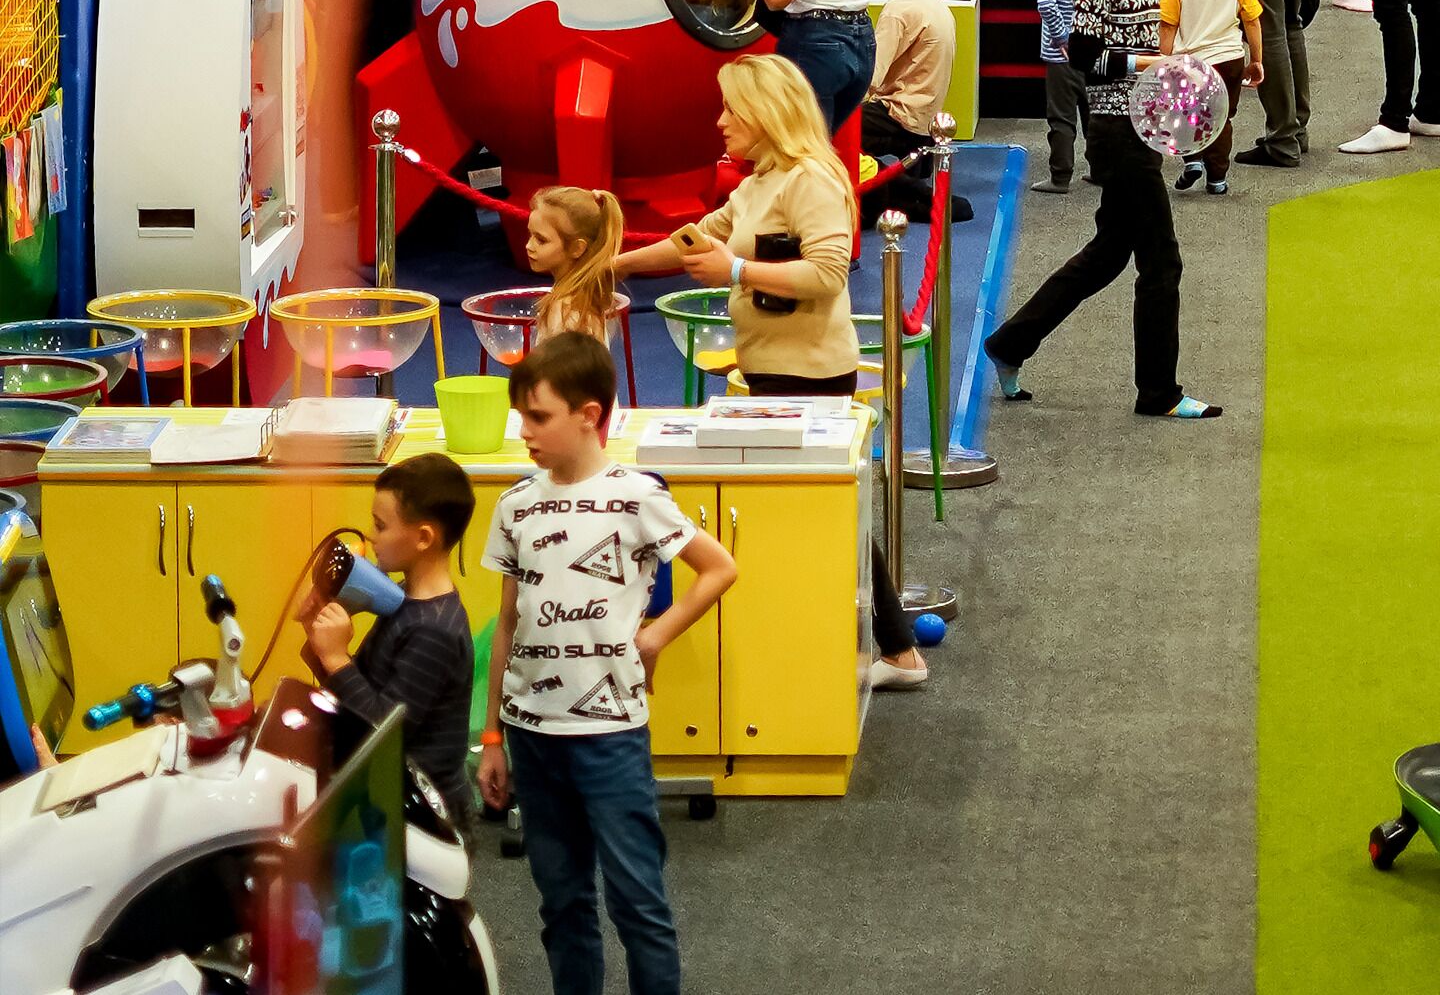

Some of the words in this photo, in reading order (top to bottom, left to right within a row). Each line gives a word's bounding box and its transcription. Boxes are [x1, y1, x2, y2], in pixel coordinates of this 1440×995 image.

[575, 499, 641, 516] SLIDE
[532, 530, 568, 552] SPIN
[536, 598, 609, 628] Skate
[564, 642, 627, 659] SLIDE
